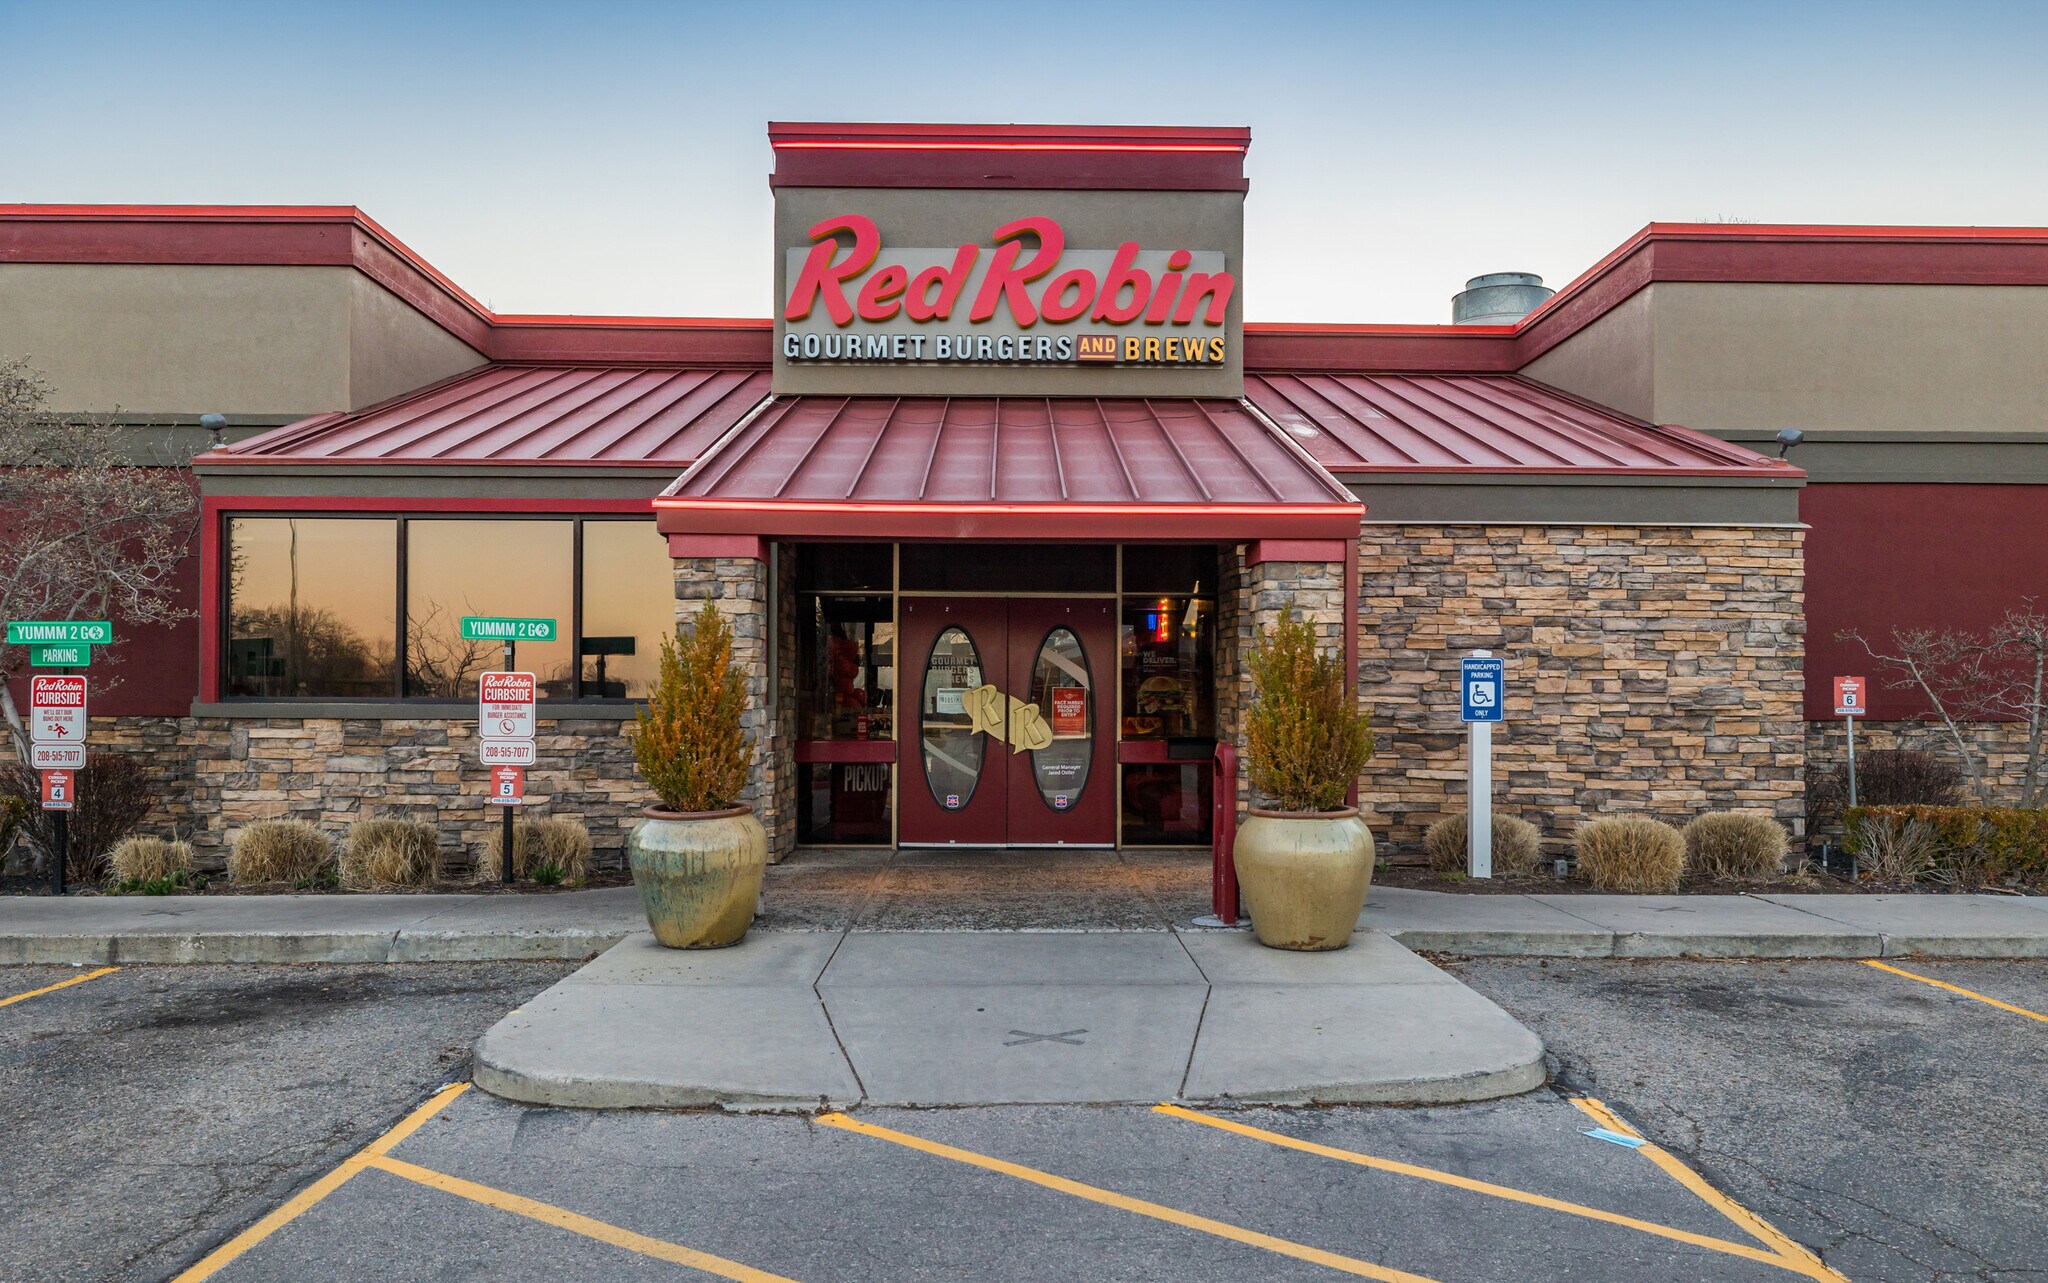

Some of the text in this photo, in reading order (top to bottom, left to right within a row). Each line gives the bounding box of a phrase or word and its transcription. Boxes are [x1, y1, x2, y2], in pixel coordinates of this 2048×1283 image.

[784, 214, 1236, 329] Red Robin
[783, 333, 1225, 362] GOURMET BURGERS AND BREWS
[17, 626, 66, 640] YUMMM
[71, 626, 78, 640] 2
[469, 621, 515, 636] YUMMM
[519, 623, 526, 636] 2
[43, 649, 78, 662] PARKING
[931, 657, 975, 665] GOURMET
[36, 679, 83, 691] Red Robin
[485, 675, 531, 687] Red Robin
[36, 692, 82, 705] CURBSIDE
[485, 688, 530, 701] CURBSIDE
[1847, 695, 1853, 705] 6
[37, 751, 80, 761] 208-515-7077
[486, 747, 529, 757] 208-515-7077
[844, 765, 888, 792] PICKUP
[54, 789, 61, 798] 4
[504, 784, 510, 794] 5
